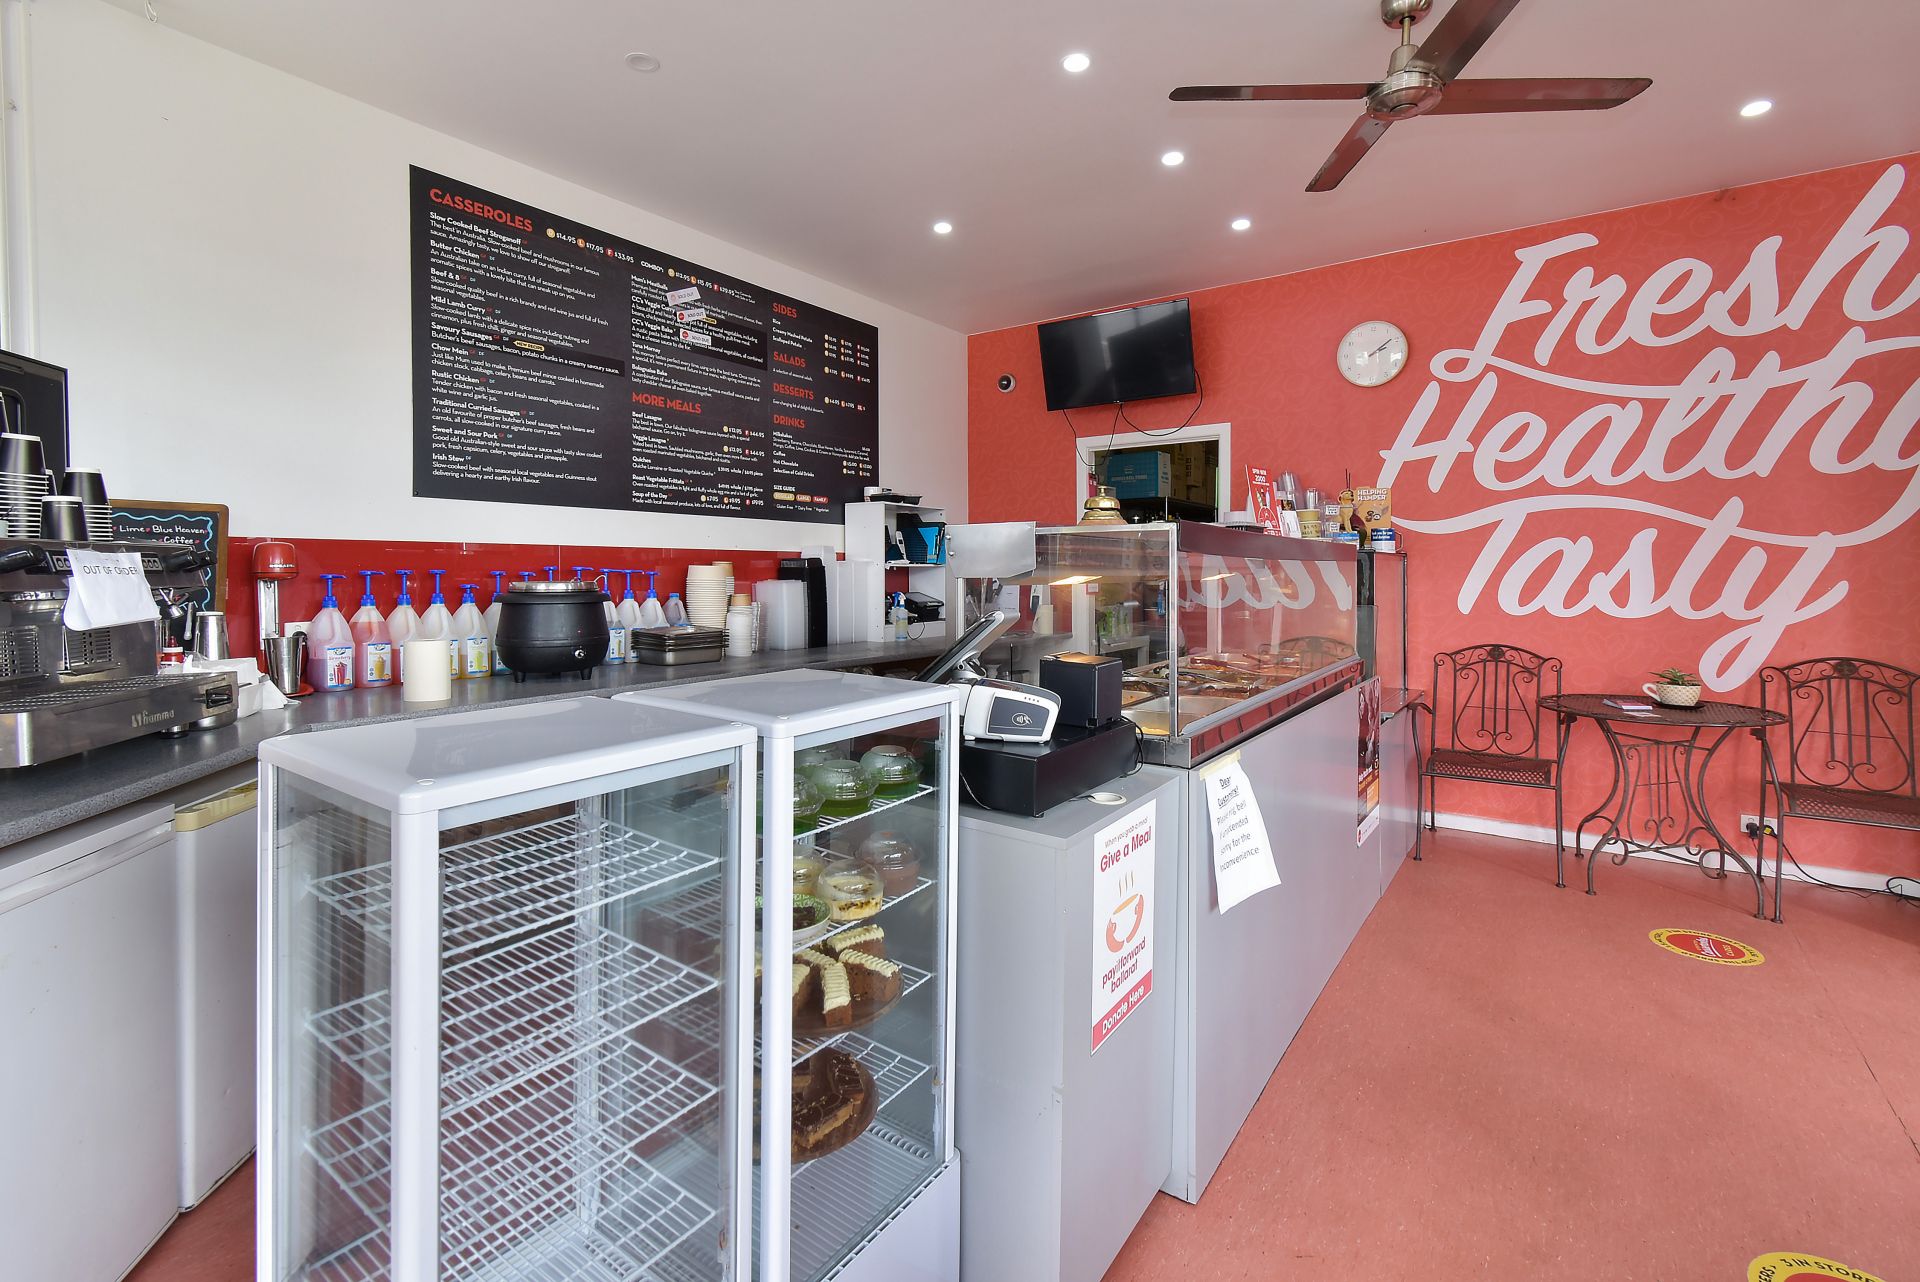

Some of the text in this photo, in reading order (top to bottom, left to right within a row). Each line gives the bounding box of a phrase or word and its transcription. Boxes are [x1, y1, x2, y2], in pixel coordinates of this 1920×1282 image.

[430, 187, 533, 233] CASSEROLES
[430, 212, 521, 246] Slow Cooked Beef Stroganoff
[431, 240, 480, 259] Butter Chicken
[431, 268, 446, 278] Beef
[1429, 163, 1920, 388] Fresh
[431, 295, 486, 315] Mild Lamb Curry
[773, 302, 797, 319] SIDES
[432, 322, 493, 341] Savoury Sausages
[432, 343, 468, 356] Chow Mein
[774, 351, 805, 368] SALADS
[432, 370, 479, 384] Rustic Chicken
[774, 383, 814, 401] DESSERTS
[432, 398, 520, 417] Traditional Curried Sausages
[632, 392, 701, 414] MORE MEALS
[433, 426, 452, 434] Sweet
[774, 415, 805, 429] DRINKS
[175, 526, 205, 534] Heaven
[163, 536, 193, 544] Coffee
[83, 565, 138, 576] OUT OF ORDER
[1456, 496, 1849, 693] Tasty
[1219, 776, 1231, 787] Dear
[1100, 826, 1151, 872] Give a Meal
[1232, 838, 1240, 848] for
[1240, 833, 1251, 842] the
[1110, 958, 1138, 993] ballarat
[1102, 985, 1145, 1035] Donate Here
[1792, 1258, 1812, 1267] IN
